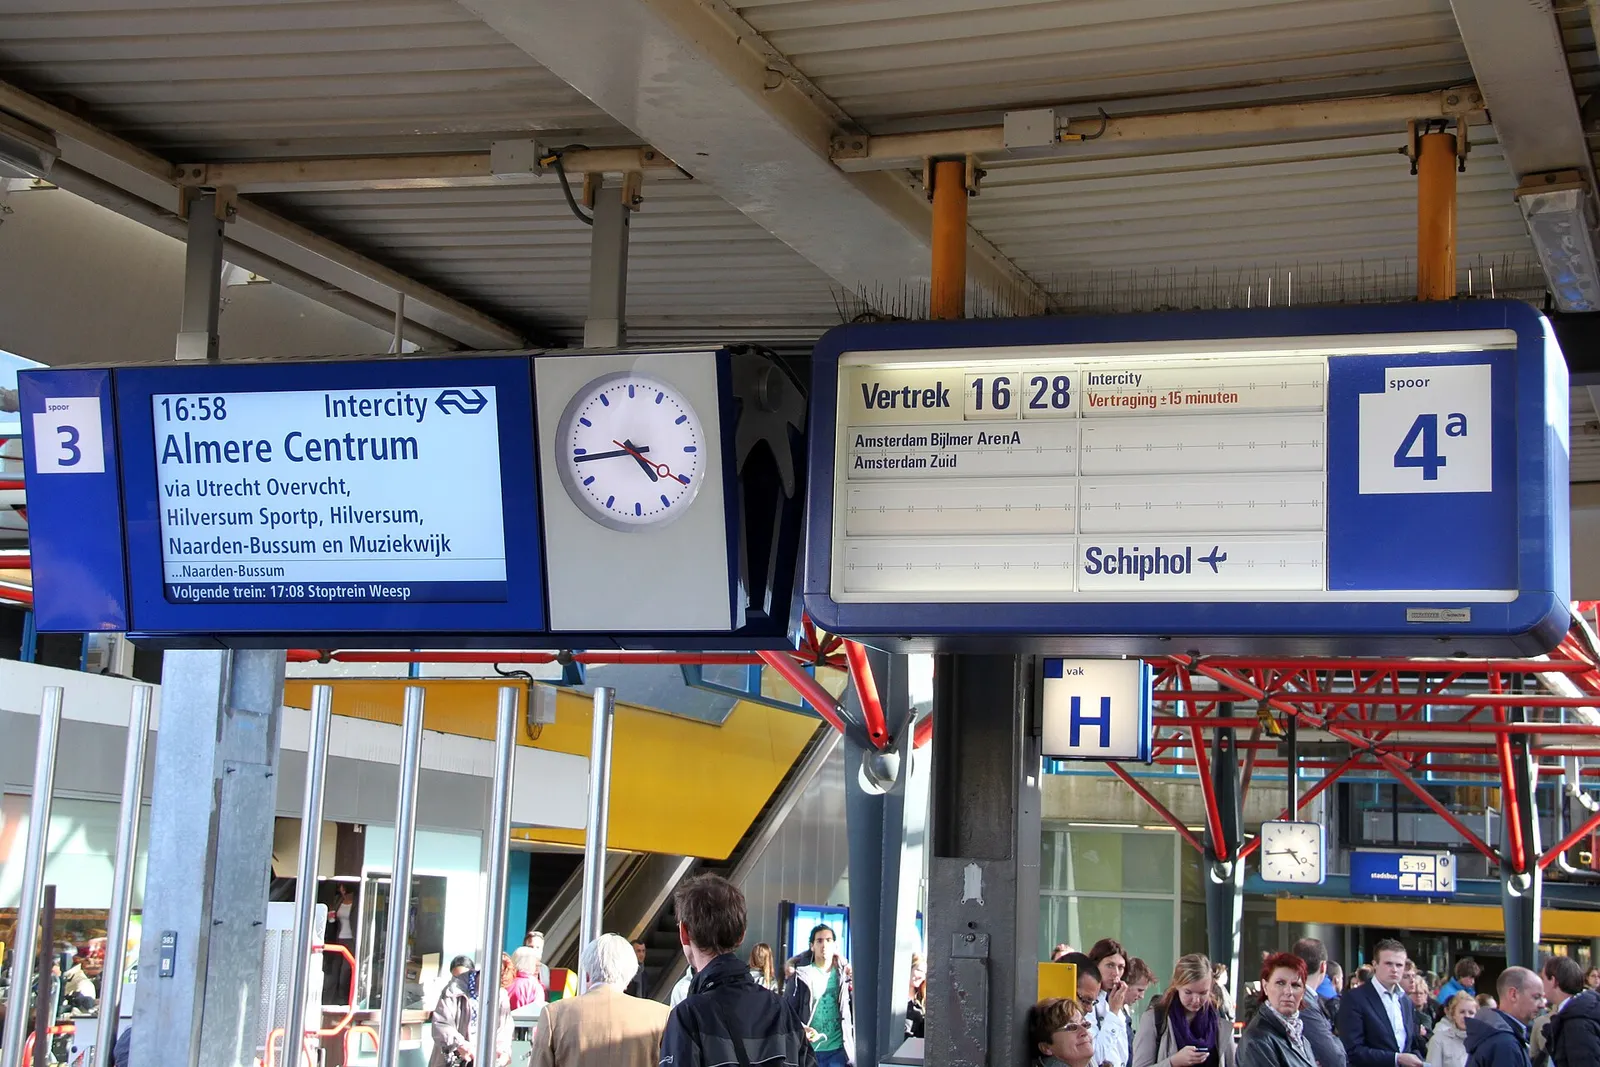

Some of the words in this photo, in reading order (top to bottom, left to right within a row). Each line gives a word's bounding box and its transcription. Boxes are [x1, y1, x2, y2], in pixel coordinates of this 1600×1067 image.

[1088, 370, 1142, 387] Intercity
[1390, 378, 1429, 391] spoor
[861, 381, 950, 409] Vertrek
[971, 377, 1010, 410] 16
[1029, 375, 1070, 410] 28
[1088, 392, 1156, 409] Vertraging
[1185, 389, 1238, 405] minuten
[48, 404, 69, 412] spoor
[161, 396, 227, 421] 16:58
[325, 392, 428, 422] Intercity
[57, 425, 81, 466] 3
[162, 431, 272, 464] Almere
[284, 431, 418, 461] Centrum
[855, 432, 927, 448] Amsterdam
[931, 431, 973, 449] Bijlmer
[977, 430, 1020, 446] ArenA
[854, 455, 927, 470] Amsterdam
[930, 453, 957, 469] Zuid
[165, 480, 190, 497] via
[196, 478, 261, 496] Utrecht
[267, 477, 351, 497] Overvcht,
[167, 507, 253, 526] Hilversum
[260, 506, 323, 529] Sportp,
[330, 505, 424, 526] Hilversum,
[169, 536, 316, 554] Naarden-Bussum
[322, 539, 343, 553] en
[349, 534, 451, 556] Muziekwijk
[172, 564, 285, 577] ...Naarden-Bussum
[1085, 546, 1191, 581] Schiphol
[172, 584, 230, 600] Volgende
[234, 584, 266, 598] trein:
[270, 584, 304, 598] 17:08
[308, 584, 366, 599] Stoptrein
[369, 584, 411, 600] Weesp
[1066, 667, 1084, 676] vak
[1069, 696, 1111, 748] H
[1416, 862, 1426, 870] 19
